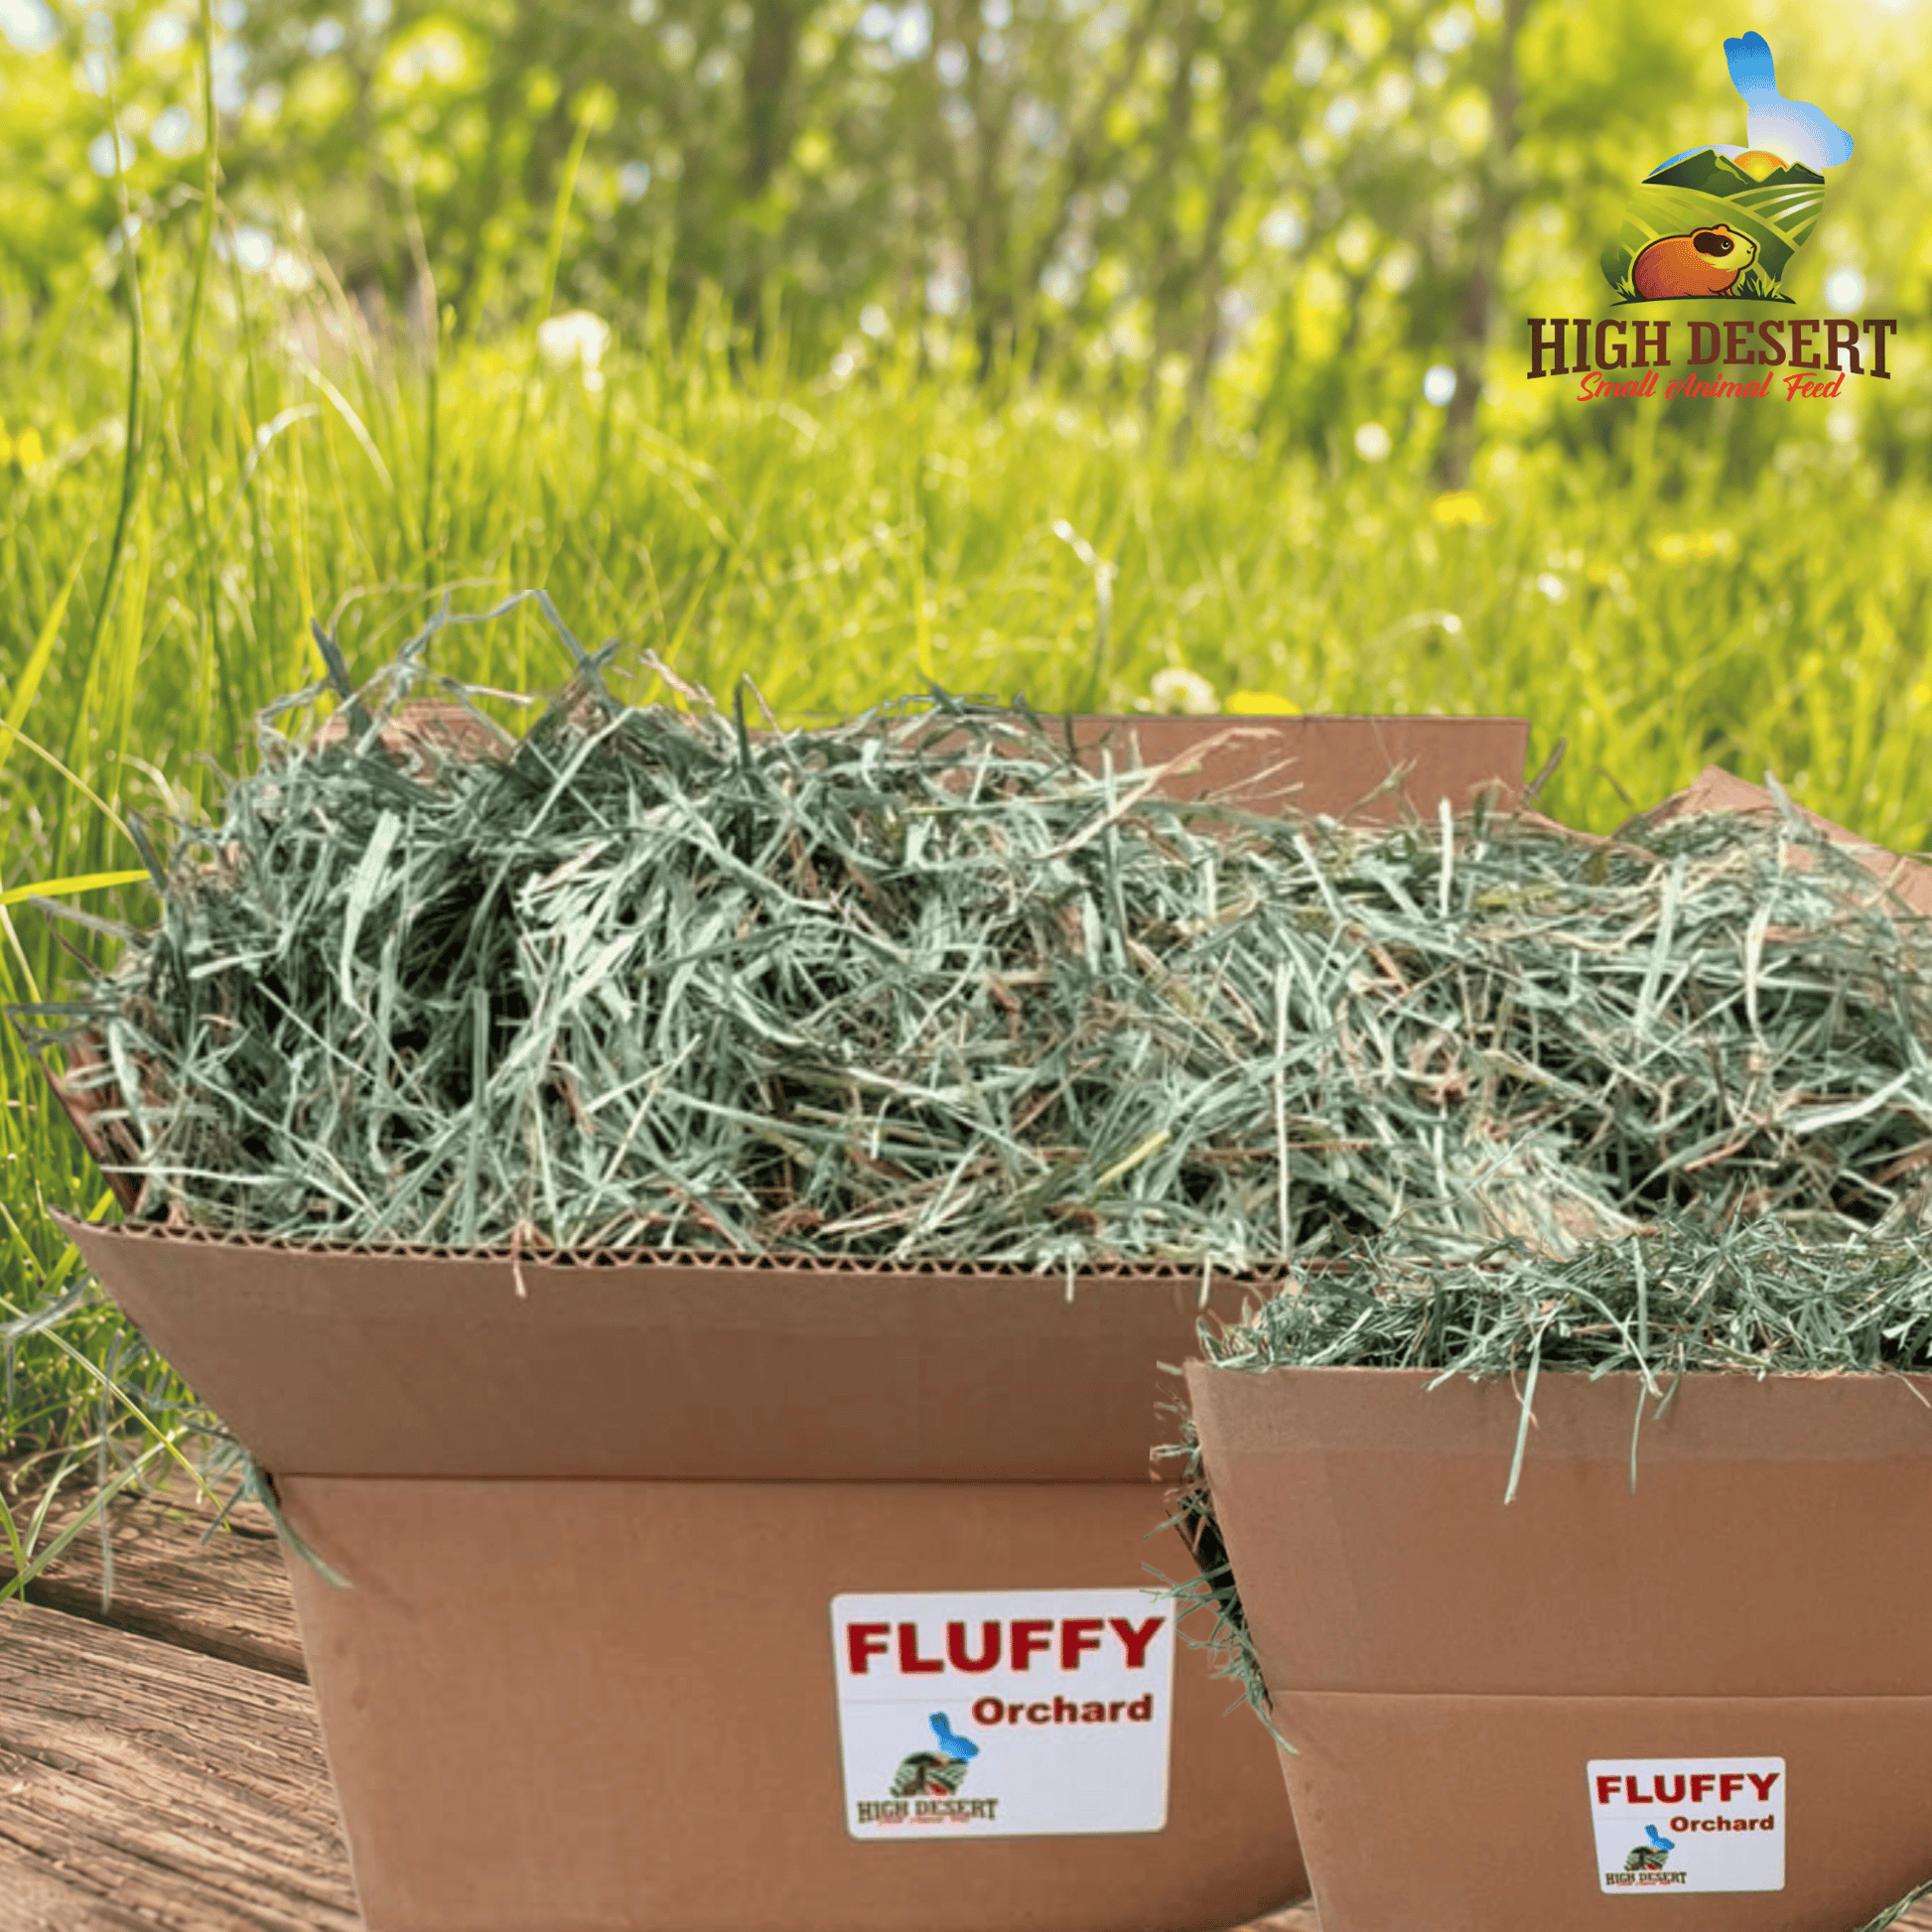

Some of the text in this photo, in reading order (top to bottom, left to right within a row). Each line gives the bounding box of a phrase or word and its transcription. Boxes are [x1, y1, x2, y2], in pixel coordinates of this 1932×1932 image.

[846, 1616, 1166, 1674] FLUFFY
[972, 1693, 1153, 1725] Orchard
[1596, 1772, 1780, 1804] FLUFFY
[857, 1799, 909, 1823] HIGH
[915, 1798, 999, 1821] DESERT
[1670, 1814, 1774, 1832] Orchard
[1605, 1872, 1635, 1885] HIGH
[1639, 1871, 1687, 1884] DESERT
